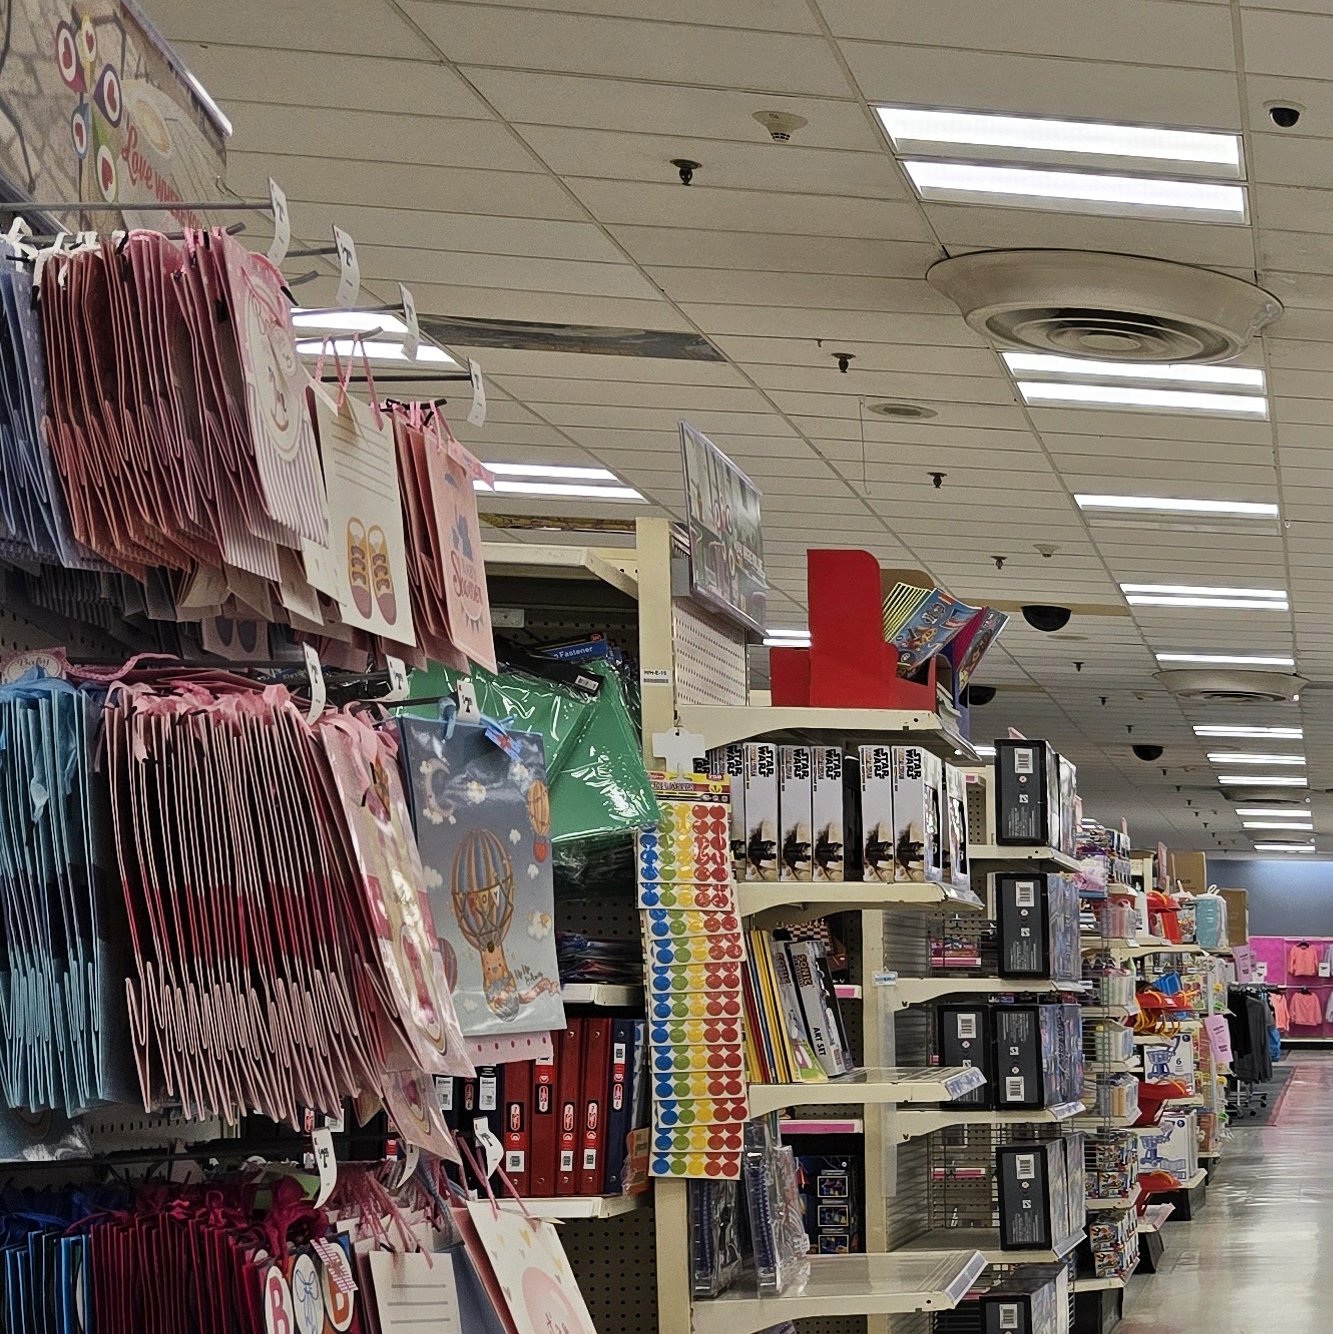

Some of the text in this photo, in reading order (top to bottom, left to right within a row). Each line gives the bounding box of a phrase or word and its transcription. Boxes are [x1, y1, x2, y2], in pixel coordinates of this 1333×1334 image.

[120, 124, 154, 191] Love
[558, 645, 594, 659] Fastener
[726, 744, 735, 777] WARS
[732, 744, 743, 777] STAR
[757, 745, 767, 778] WARS
[764, 745, 774, 776] STAR
[793, 748, 802, 780] WARS
[800, 748, 809, 777] STAR
[825, 749, 834, 781] WARS
[832, 748, 841, 779] STAR
[873, 747, 883, 779] WARS
[881, 748, 890, 778] STAR
[905, 748, 915, 780] WARS
[914, 748, 922, 778] STAR
[798, 953, 814, 988] SONIC
[812, 1027, 828, 1056] ART SET
